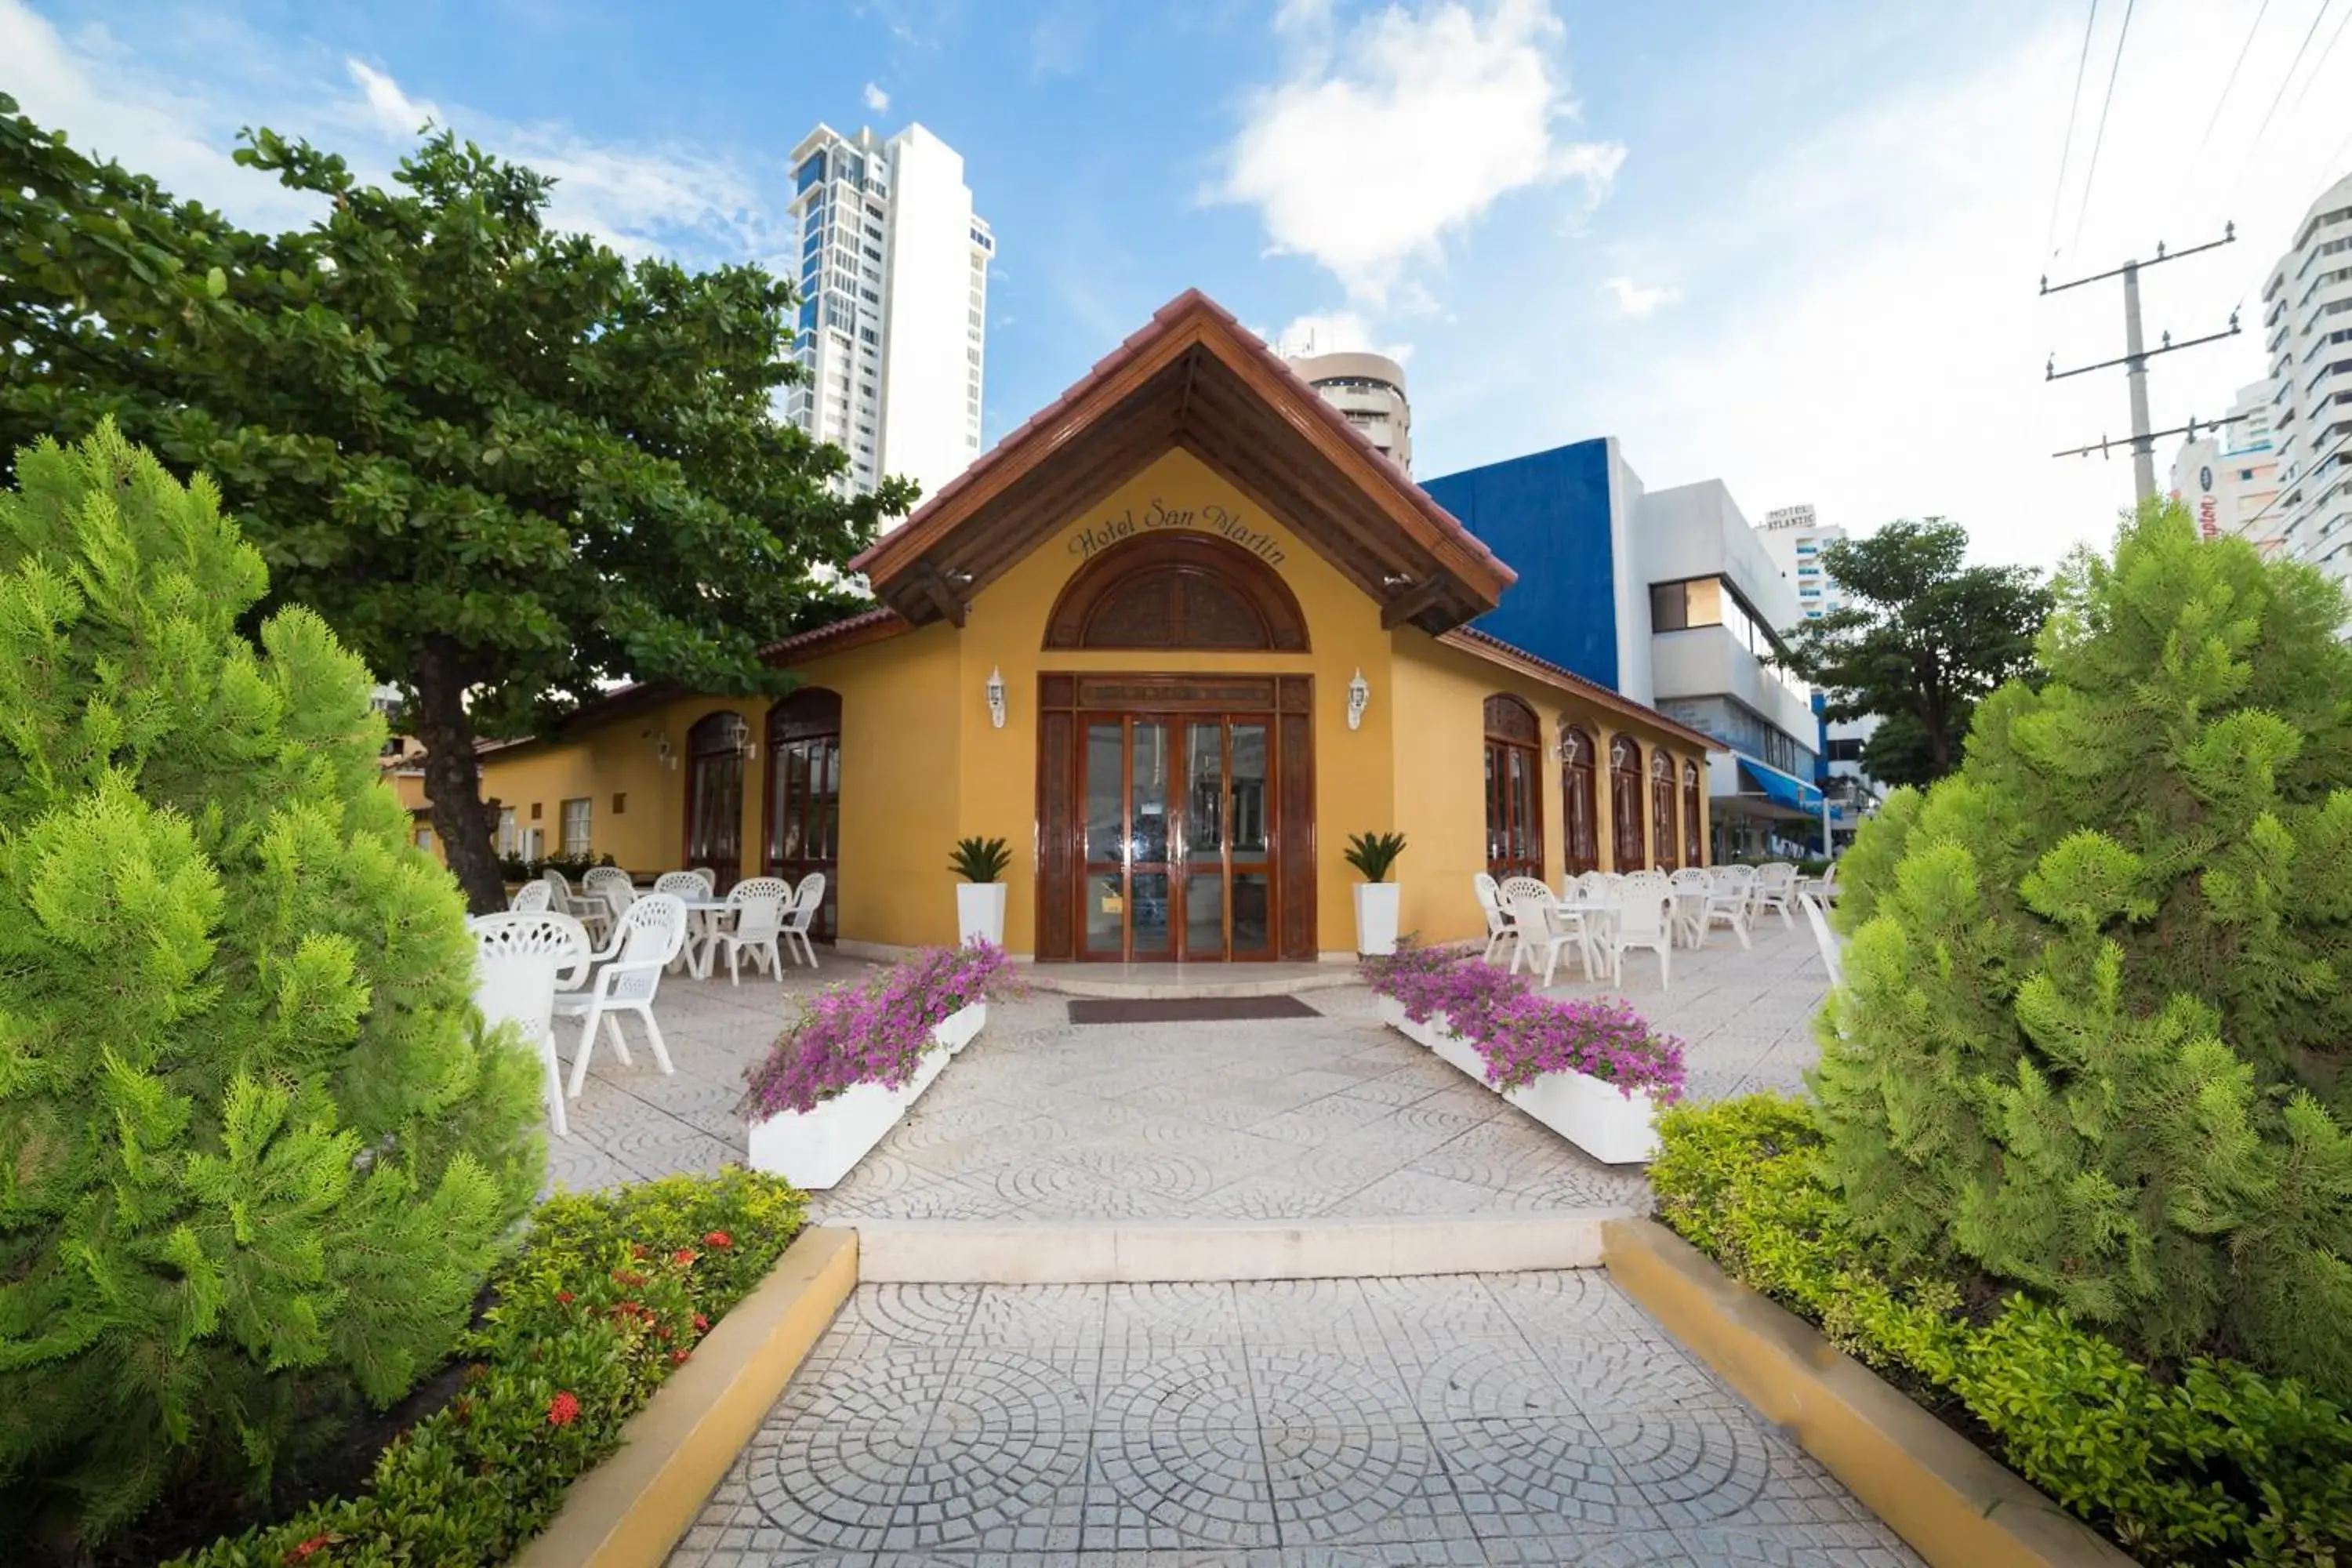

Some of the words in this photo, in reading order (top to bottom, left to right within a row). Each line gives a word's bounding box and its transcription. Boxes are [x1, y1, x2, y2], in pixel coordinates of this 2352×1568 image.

[1067, 509, 1139, 559] Hotel
[1144, 496, 1196, 528] San
[1201, 504, 1287, 566] Martin
[1769, 504, 1806, 518] HOTEL
[2198, 495, 2225, 540] pton
